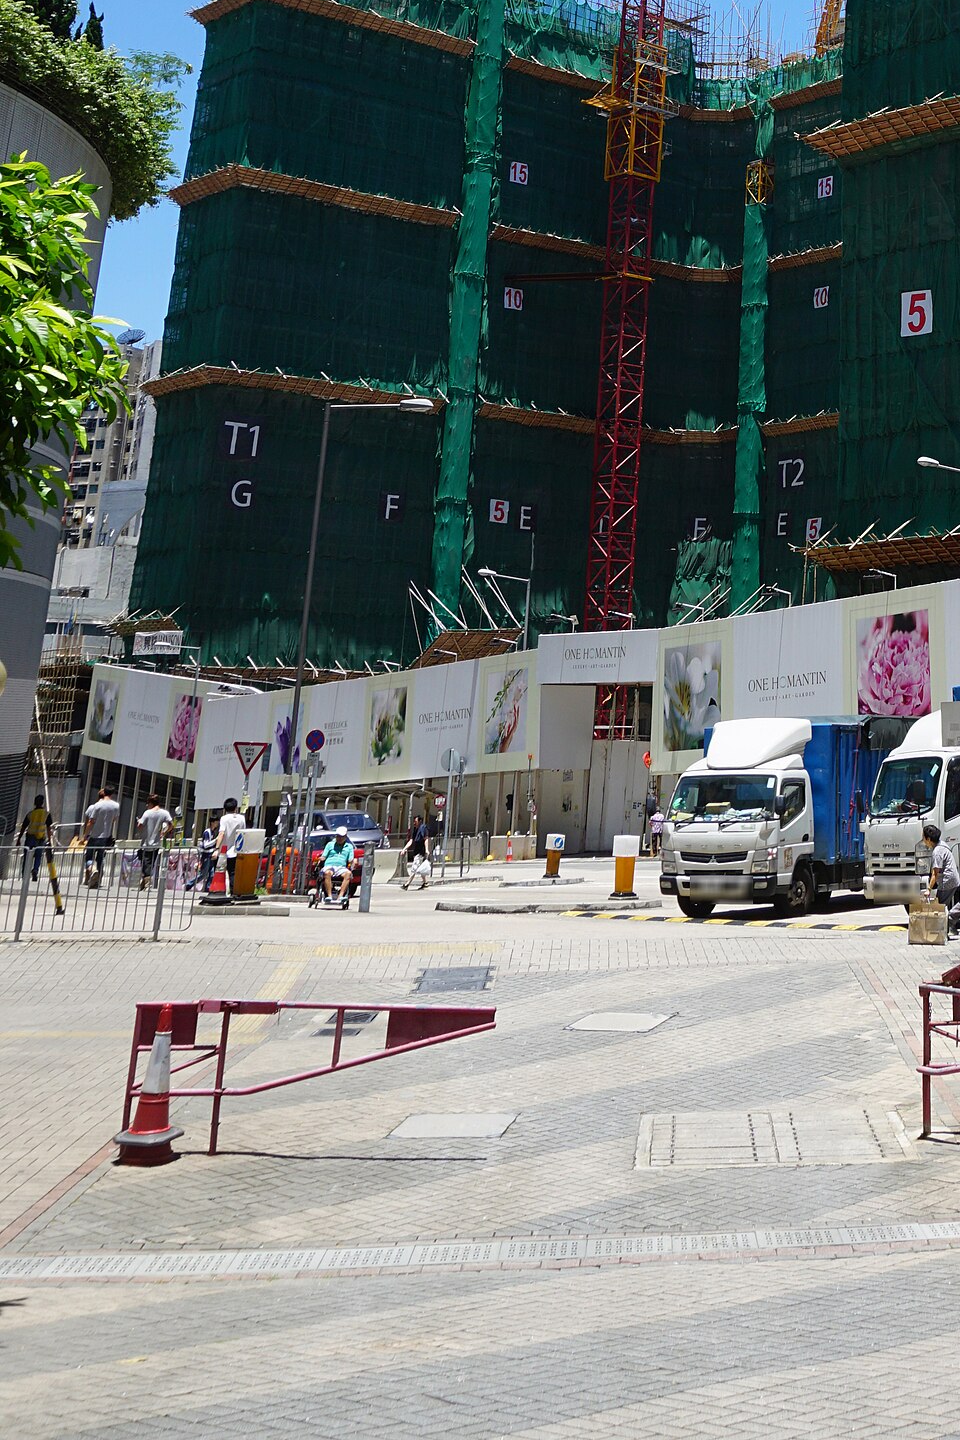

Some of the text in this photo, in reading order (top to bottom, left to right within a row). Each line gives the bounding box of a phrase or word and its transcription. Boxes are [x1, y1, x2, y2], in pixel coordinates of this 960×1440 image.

[511, 164, 528, 184] 15
[818, 178, 833, 197] 15
[505, 288, 522, 309] 10
[814, 287, 829, 307] 10
[907, 293, 927, 333] 5
[224, 420, 260, 458] T1
[778, 458, 805, 488] T2
[231, 479, 252, 509] G
[385, 494, 400, 520] F
[493, 501, 505, 523] 5
[520, 505, 532, 530] E
[777, 512, 788, 536] E
[809, 519, 818, 539] 5
[565, 646, 627, 661] ONE HOMANTIN
[748, 670, 827, 692] ONE HOMANTIN
[419, 712, 433, 724] ONE
